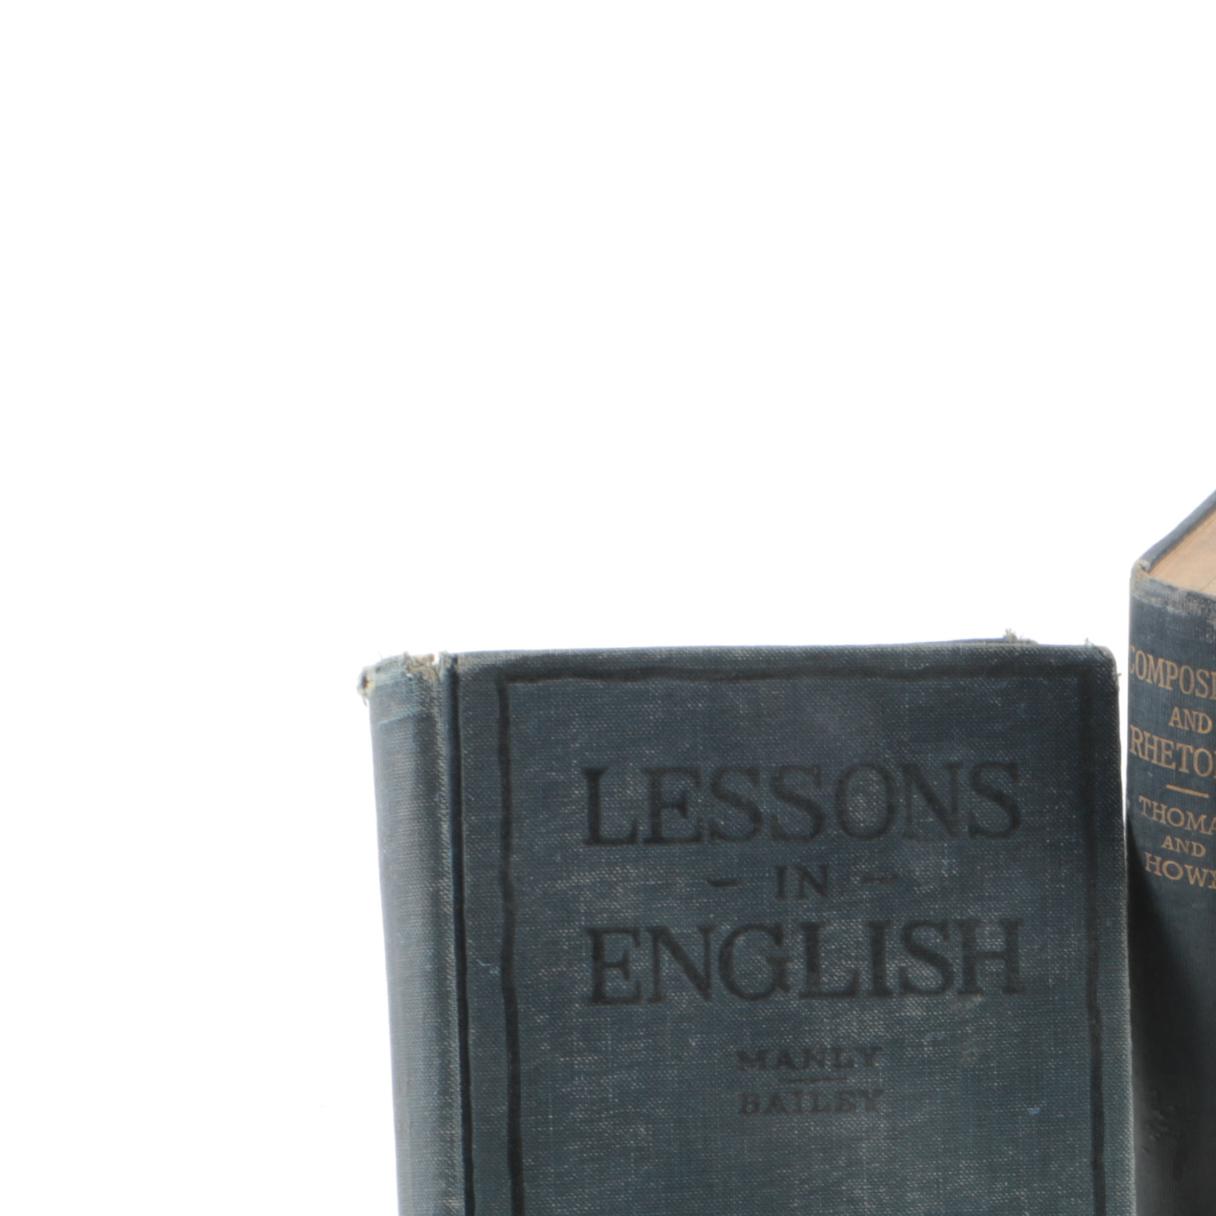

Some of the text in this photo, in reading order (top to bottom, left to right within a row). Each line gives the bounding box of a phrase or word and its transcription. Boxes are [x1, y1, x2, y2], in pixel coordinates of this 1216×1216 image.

[1168, 706, 1213, 735] AND
[582, 761, 1023, 847] LESSONS
[1161, 835, 1206, 857] AND
[776, 864, 830, 899] IN
[587, 918, 1025, 1005] ENGLISH
[736, 1046, 882, 1072] MANLY
[739, 1089, 885, 1116] BAILEY
